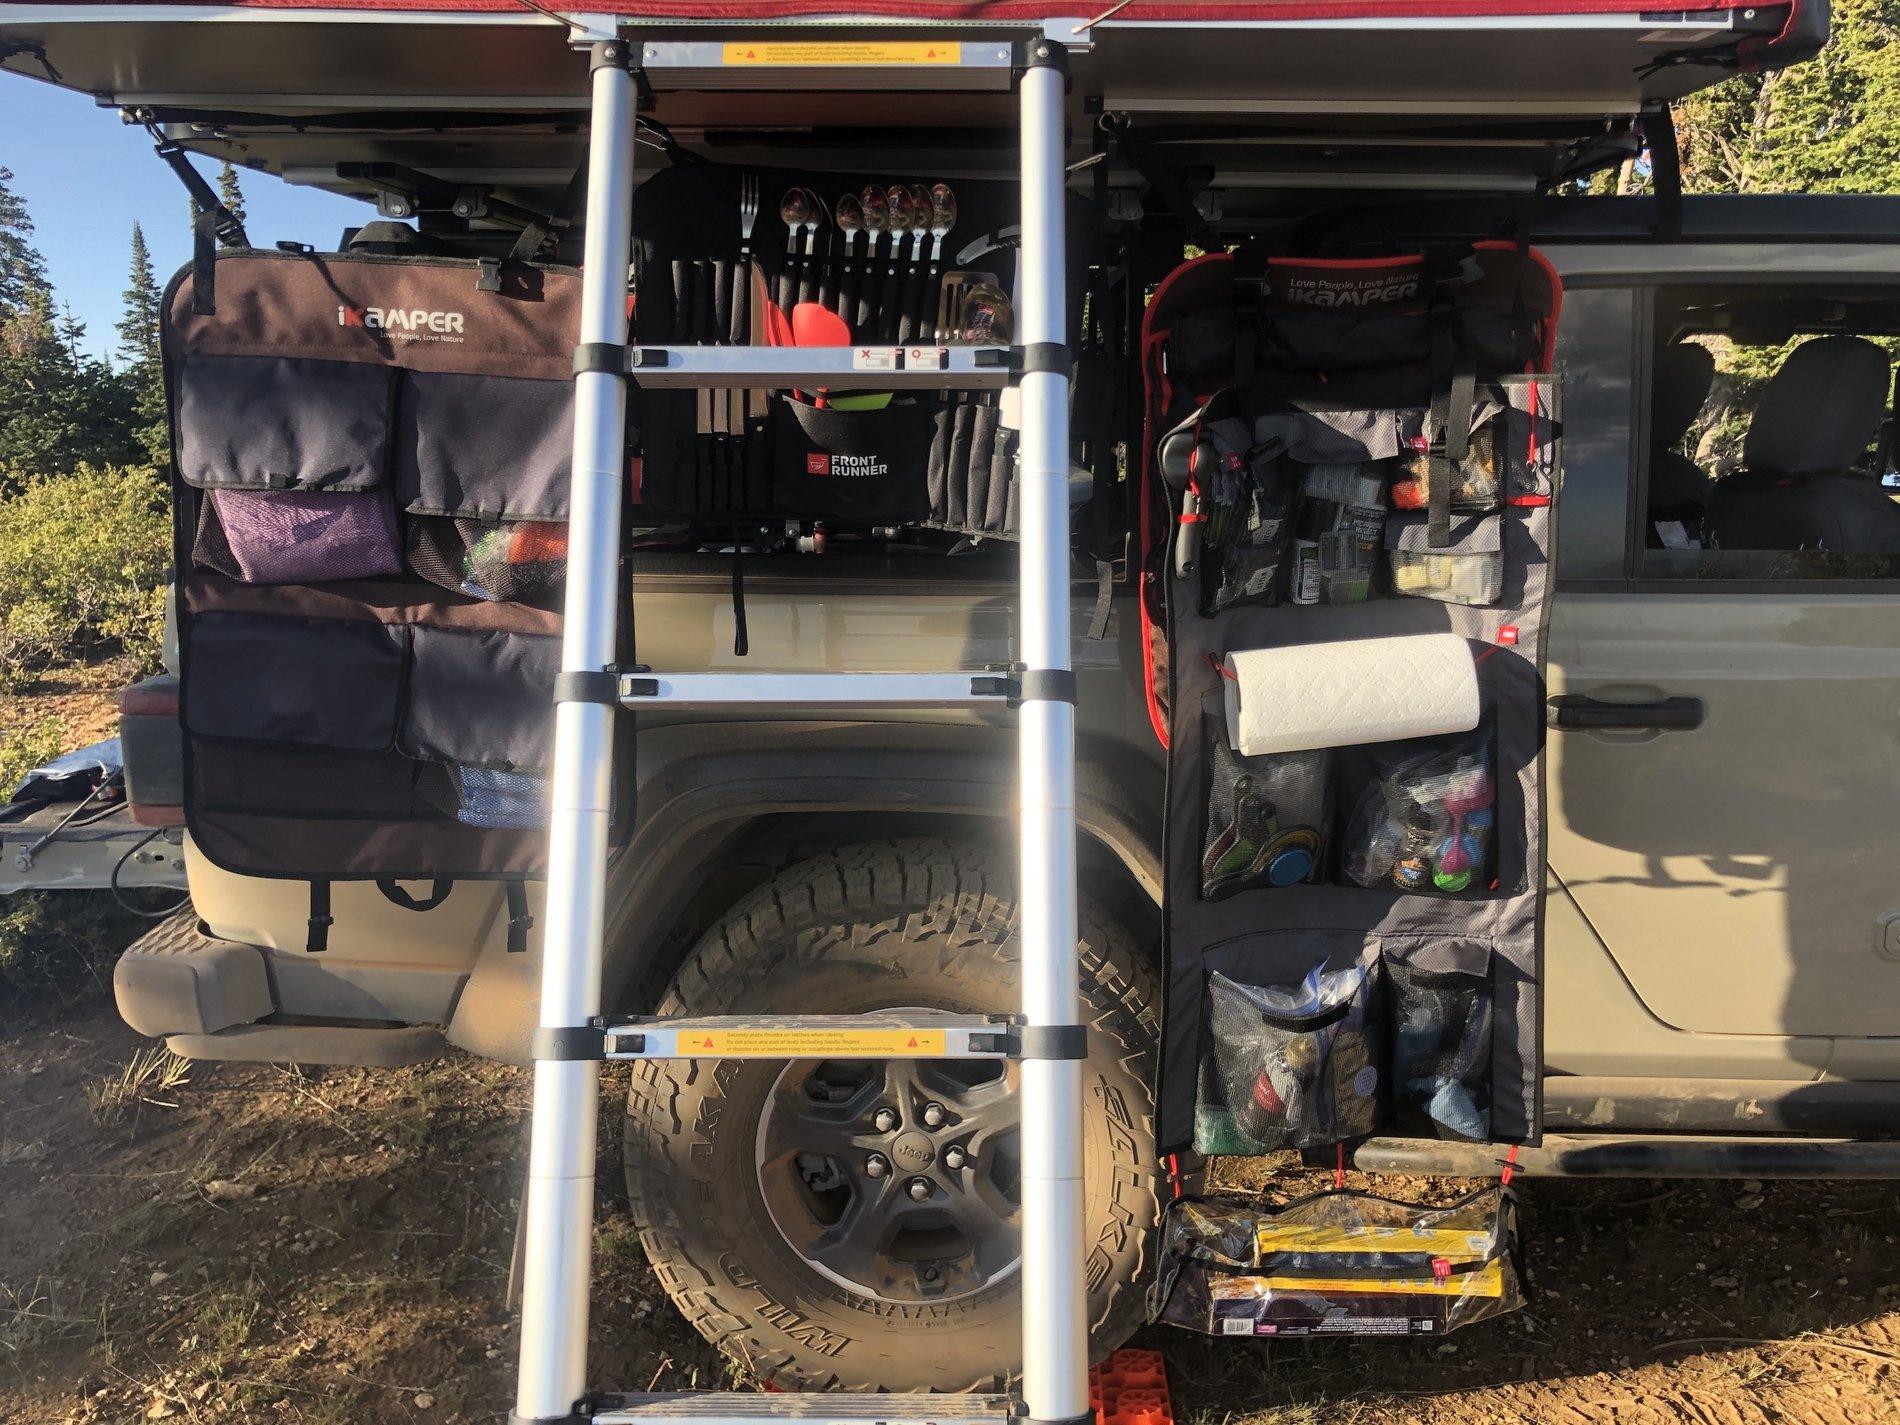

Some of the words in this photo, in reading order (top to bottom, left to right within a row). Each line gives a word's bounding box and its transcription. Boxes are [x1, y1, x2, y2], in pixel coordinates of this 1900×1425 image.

[1290, 278, 1316, 288] Love
[1359, 280, 1384, 290] Love
[1385, 273, 1419, 286] Nature
[380, 331, 396, 340] Love
[397, 332, 422, 342] People,
[423, 334, 439, 342] Love
[440, 335, 464, 344] Nature
[831, 455, 877, 467] FRONT
[831, 464, 888, 477] RUNNER
[899, 1145, 931, 1162] Jeep
[1087, 1073, 1139, 1294] FALKE
